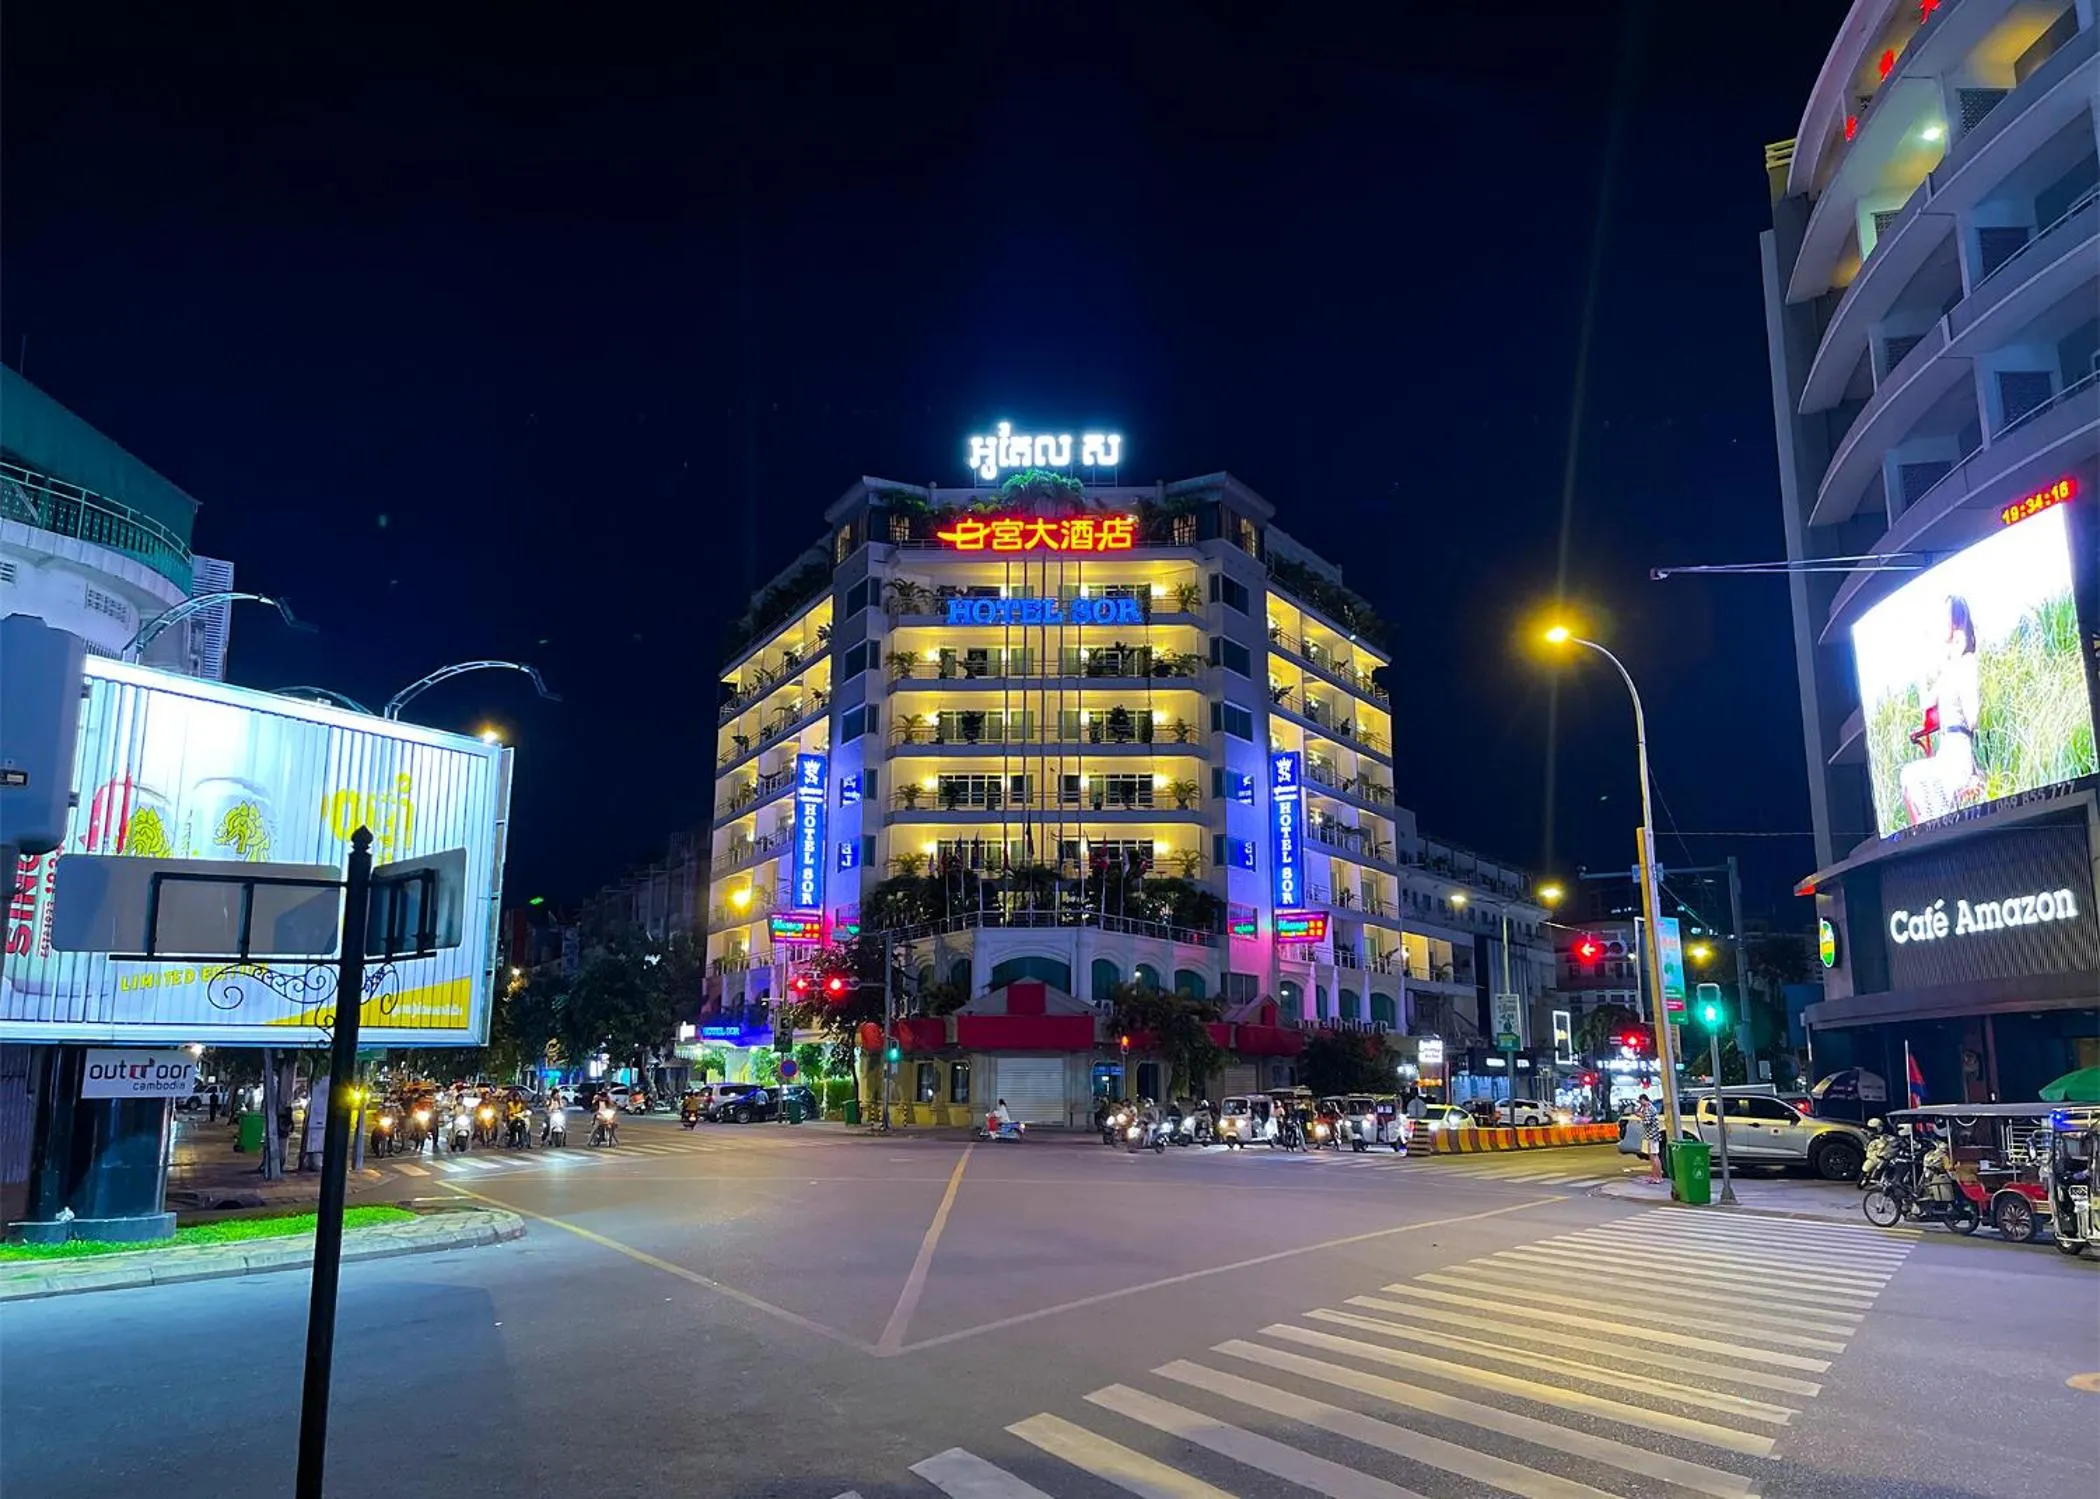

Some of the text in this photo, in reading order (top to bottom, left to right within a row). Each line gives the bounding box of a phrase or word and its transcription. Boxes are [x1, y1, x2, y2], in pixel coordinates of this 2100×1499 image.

[937, 517, 1134, 551] 白宮大酒店
[947, 598, 1143, 625] HOTEL SOR
[803, 803, 816, 865] HOTEL
[1279, 801, 1292, 863] HOTEL
[801, 867, 814, 905] SOR
[1281, 867, 1294, 905] SOR
[1889, 898, 1949, 944] Café
[1955, 887, 2079, 936] Amazon
[120, 968, 196, 992] LIMITED
